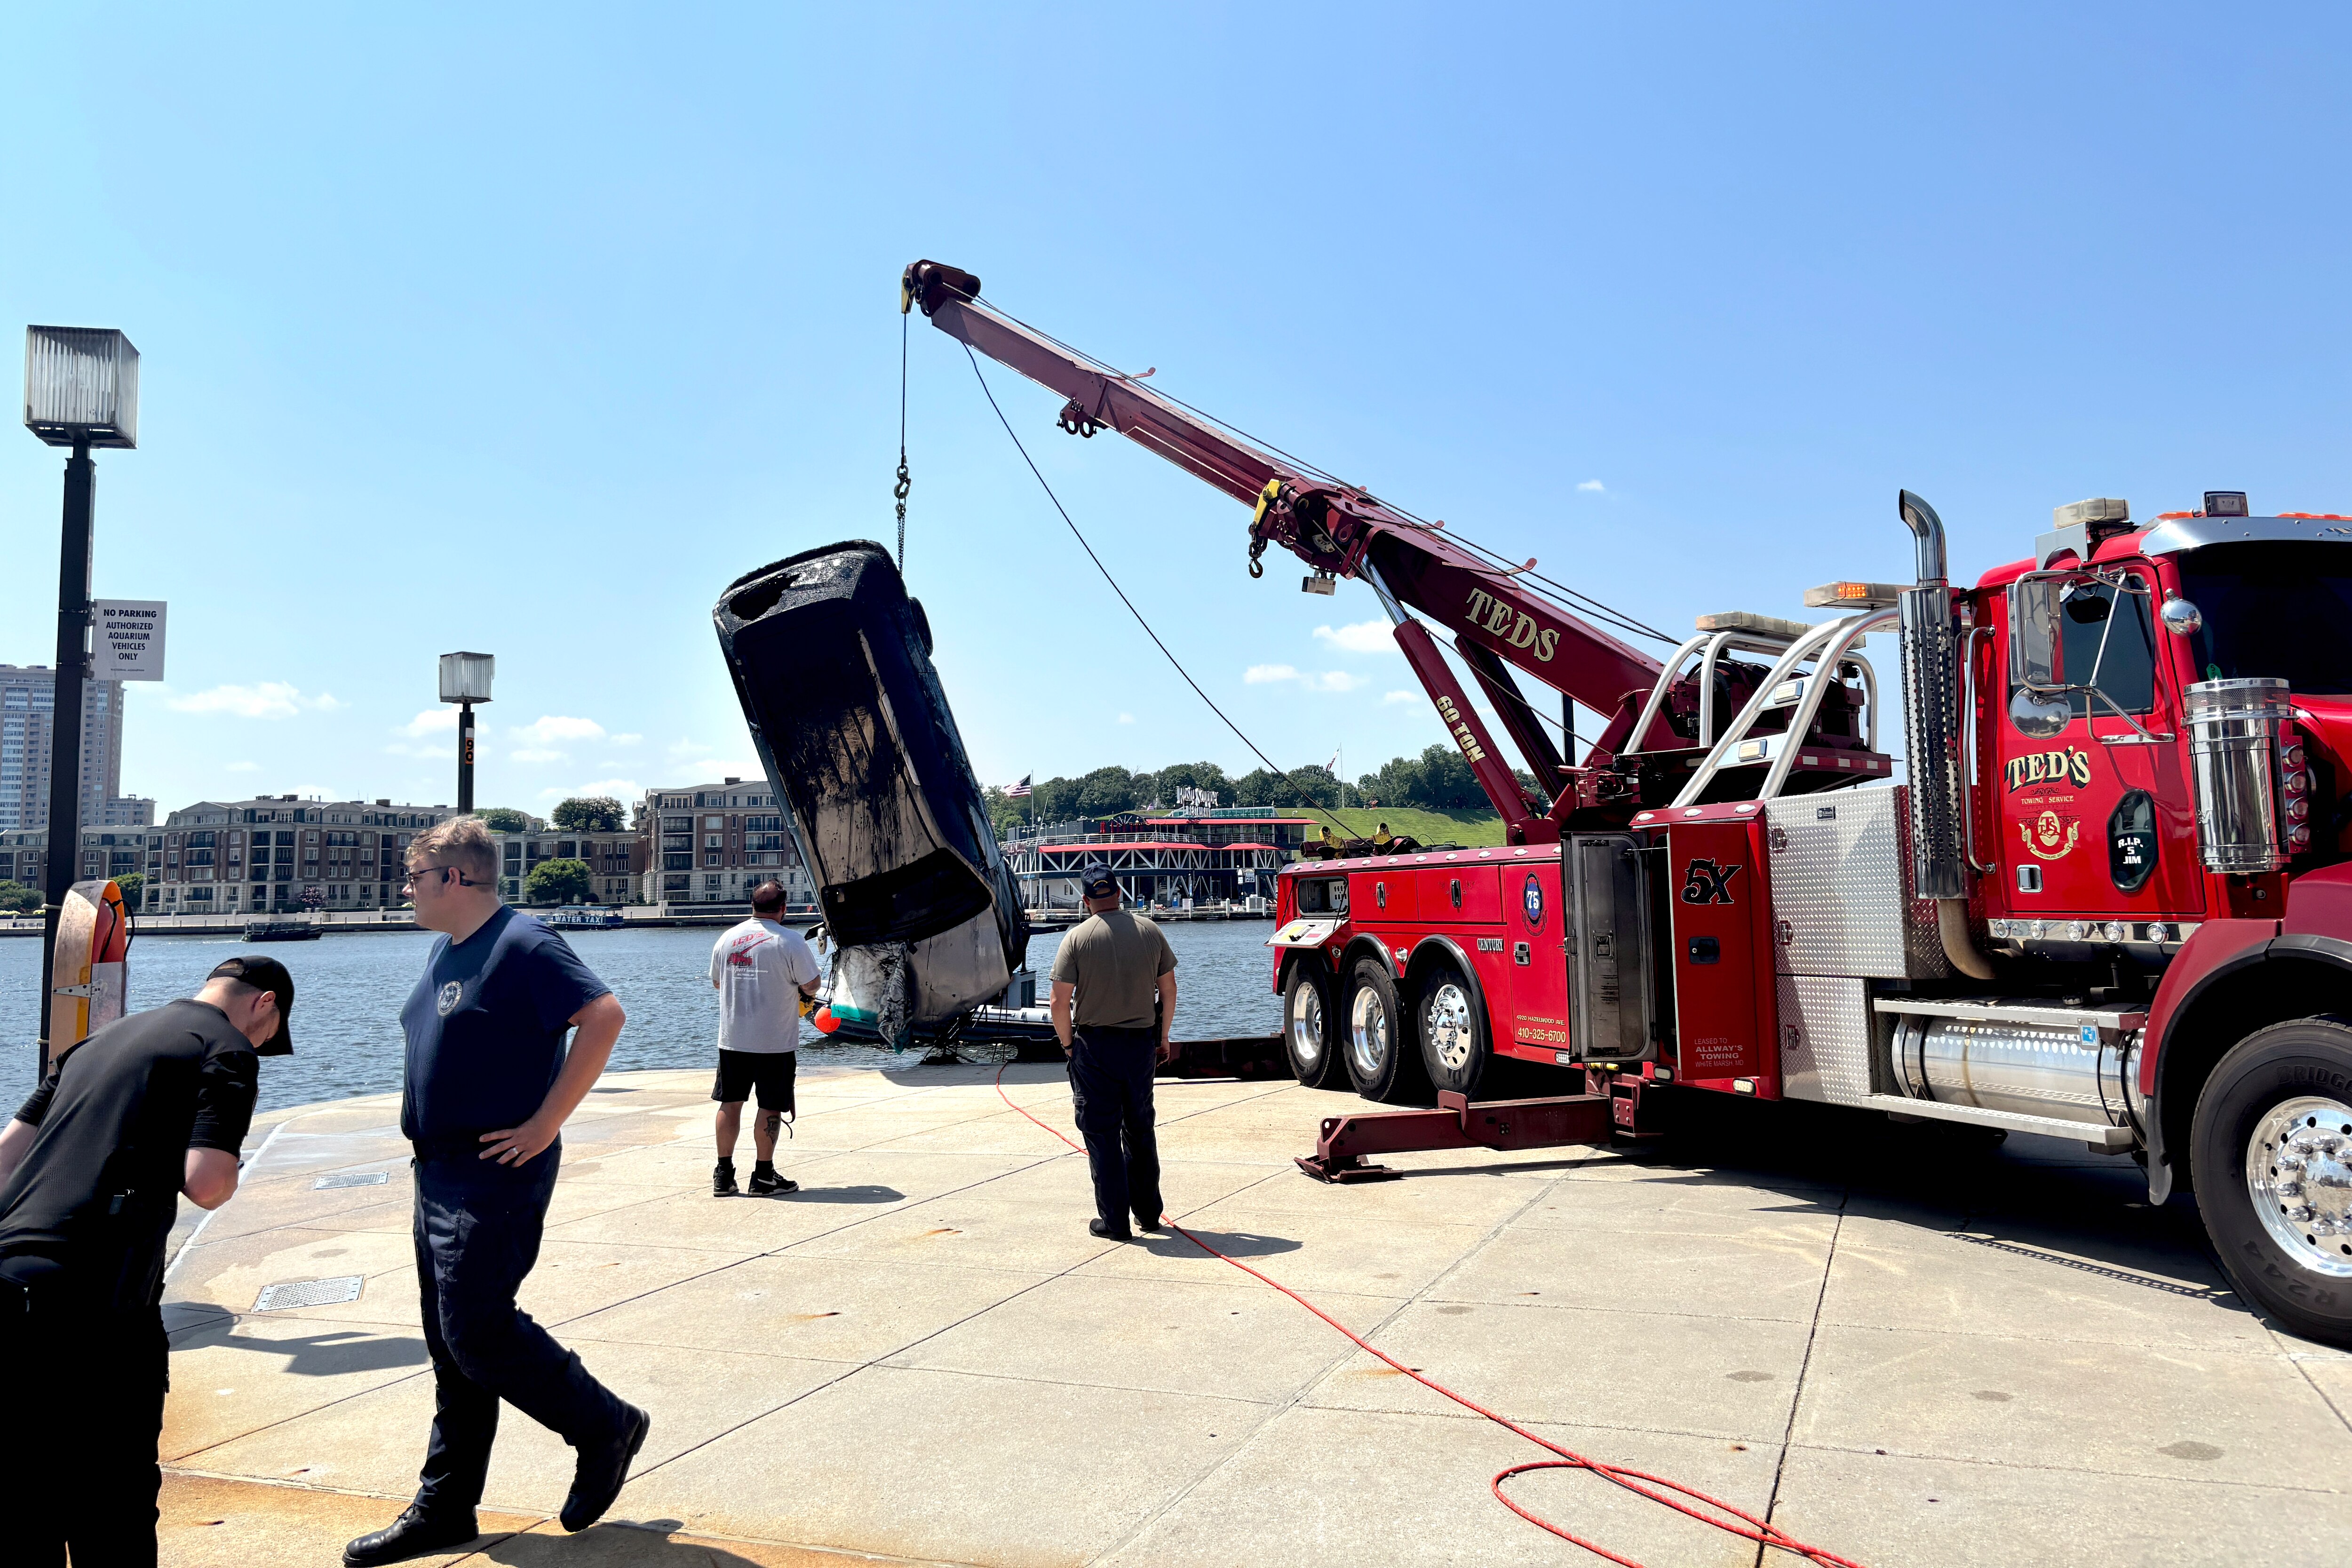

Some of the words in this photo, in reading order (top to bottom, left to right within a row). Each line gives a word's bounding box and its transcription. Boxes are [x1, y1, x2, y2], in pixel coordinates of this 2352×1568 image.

[119, 609, 157, 618] PARKING
[106, 621, 153, 630] AUTHORIZED
[1465, 588, 1560, 662] TEDS
[108, 632, 150, 640] AQUARIUM
[112, 642, 145, 650] VEHICLES
[1436, 695, 1460, 723] 60
[1453, 722, 1486, 763] TON
[2005, 745, 2091, 790] TED'S
[2118, 837, 2143, 848] R.I.P.
[1681, 858, 1742, 905] 5X
[1527, 891, 1539, 909] 75
[1477, 938, 1503, 951] CENTURY
[1518, 1027, 1566, 1043] 410-325-6700
